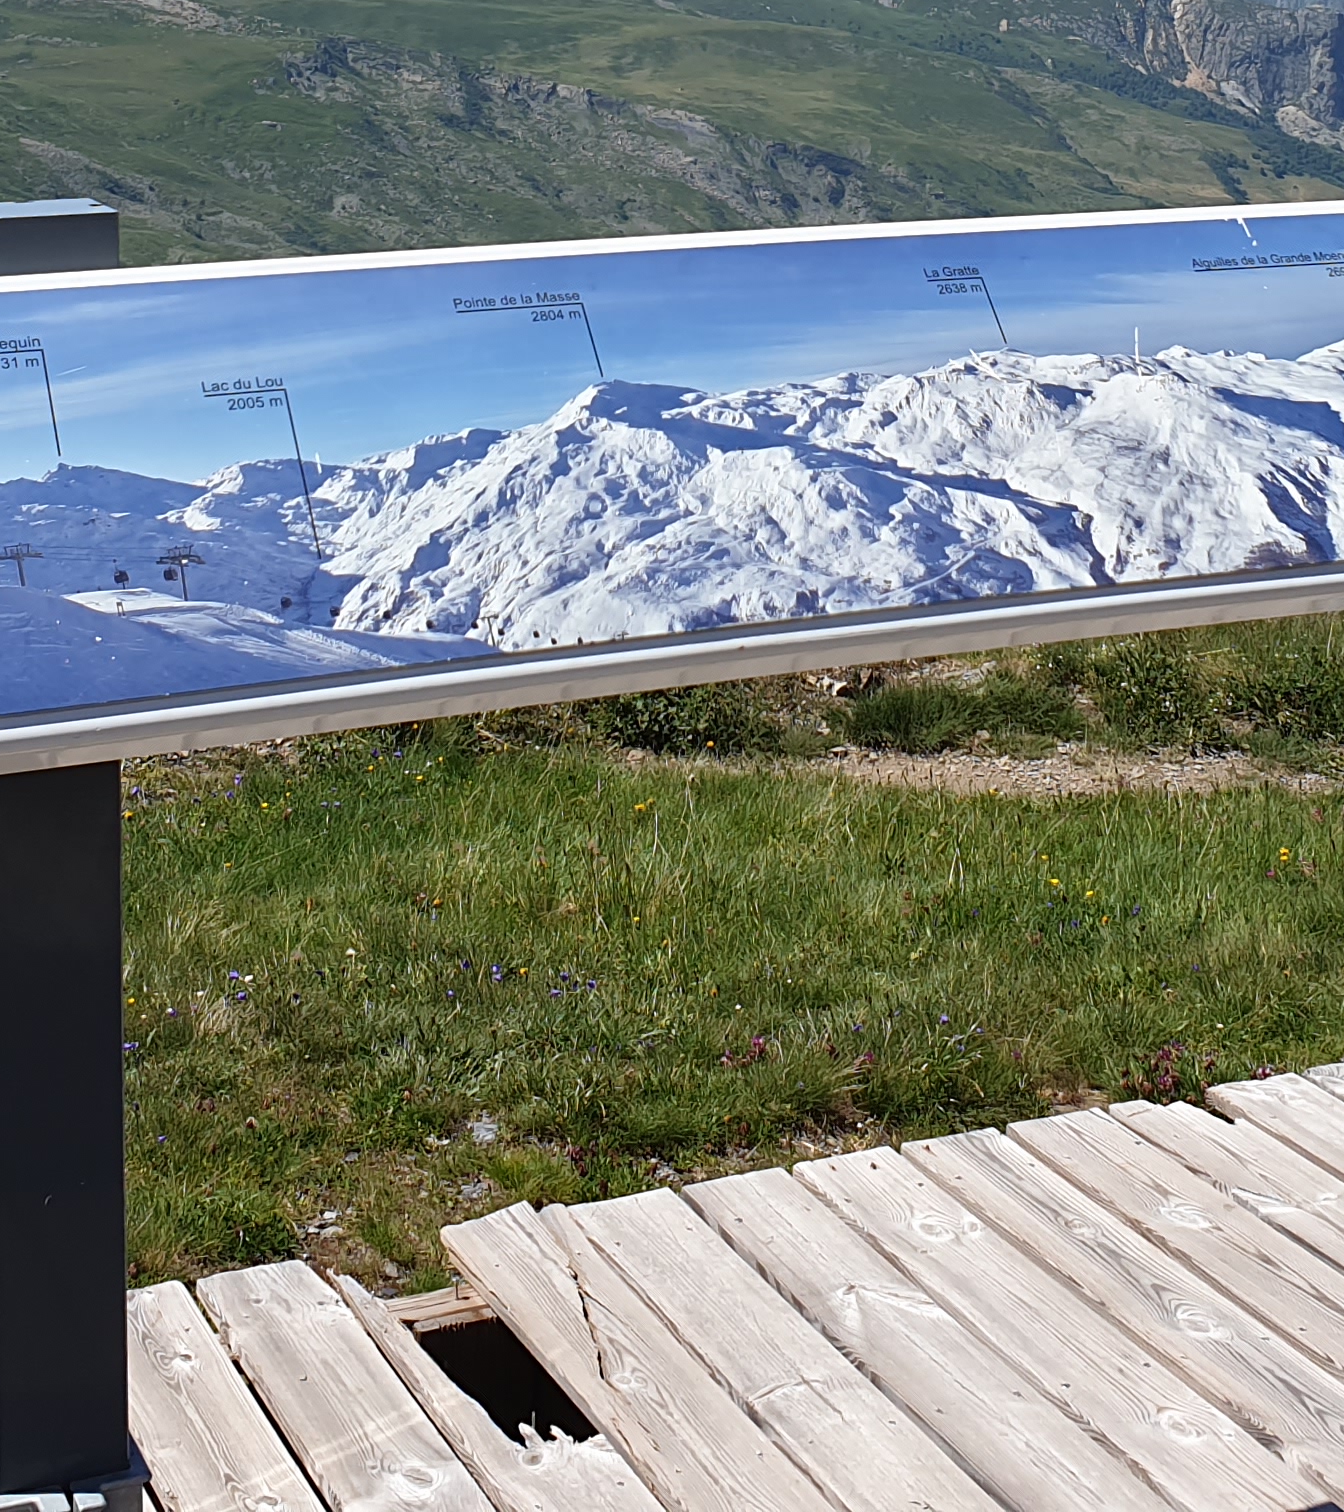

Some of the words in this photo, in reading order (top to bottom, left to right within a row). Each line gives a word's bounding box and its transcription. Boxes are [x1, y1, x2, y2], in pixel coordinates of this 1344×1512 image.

[1192, 257, 1239, 270] Aiguilles
[1241, 255, 1255, 266] de
[1257, 254, 1268, 265] la
[1270, 253, 1312, 264] Grande
[923, 268, 940, 278] La
[942, 266, 980, 277] Gratte
[937, 282, 968, 295] 2638
[970, 284, 982, 293] m
[453, 297, 496, 309] Pointe
[500, 295, 517, 306] de
[521, 293, 533, 304] la
[535, 291, 581, 304] Masse
[531, 309, 564, 323] 2804
[568, 310, 582, 320] m
[24, 356, 41, 369] m
[201, 380, 230, 393] Lac
[233, 378, 252, 390] du
[255, 376, 284, 389] Lou
[227, 396, 265, 411] 2005
[269, 396, 284, 408] m
